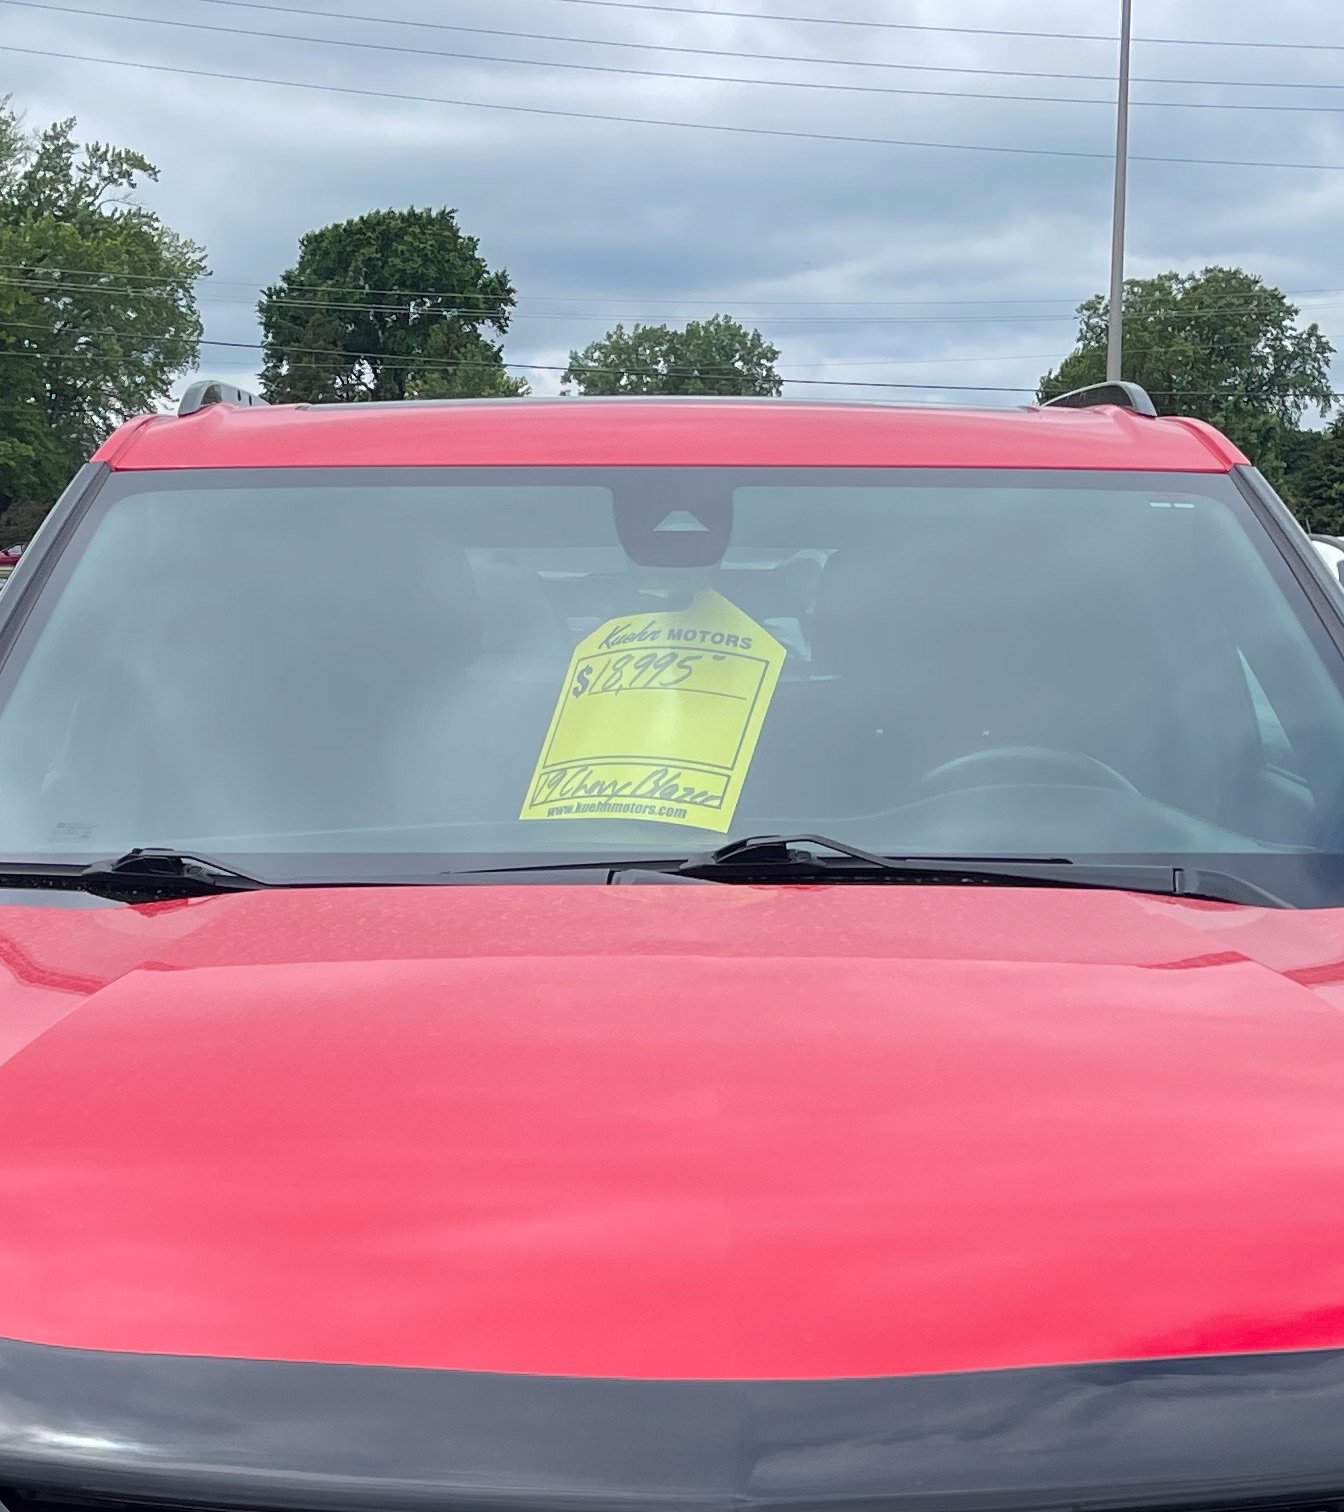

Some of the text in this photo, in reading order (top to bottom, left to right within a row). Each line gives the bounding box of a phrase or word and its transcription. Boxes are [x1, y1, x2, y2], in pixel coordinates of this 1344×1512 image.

[598, 620, 753, 651] Kuehn MOTORS
[559, 764, 633, 801] Chevy
[630, 765, 722, 806] Blazer
[547, 800, 687, 819] www.kuehnmotors.com
